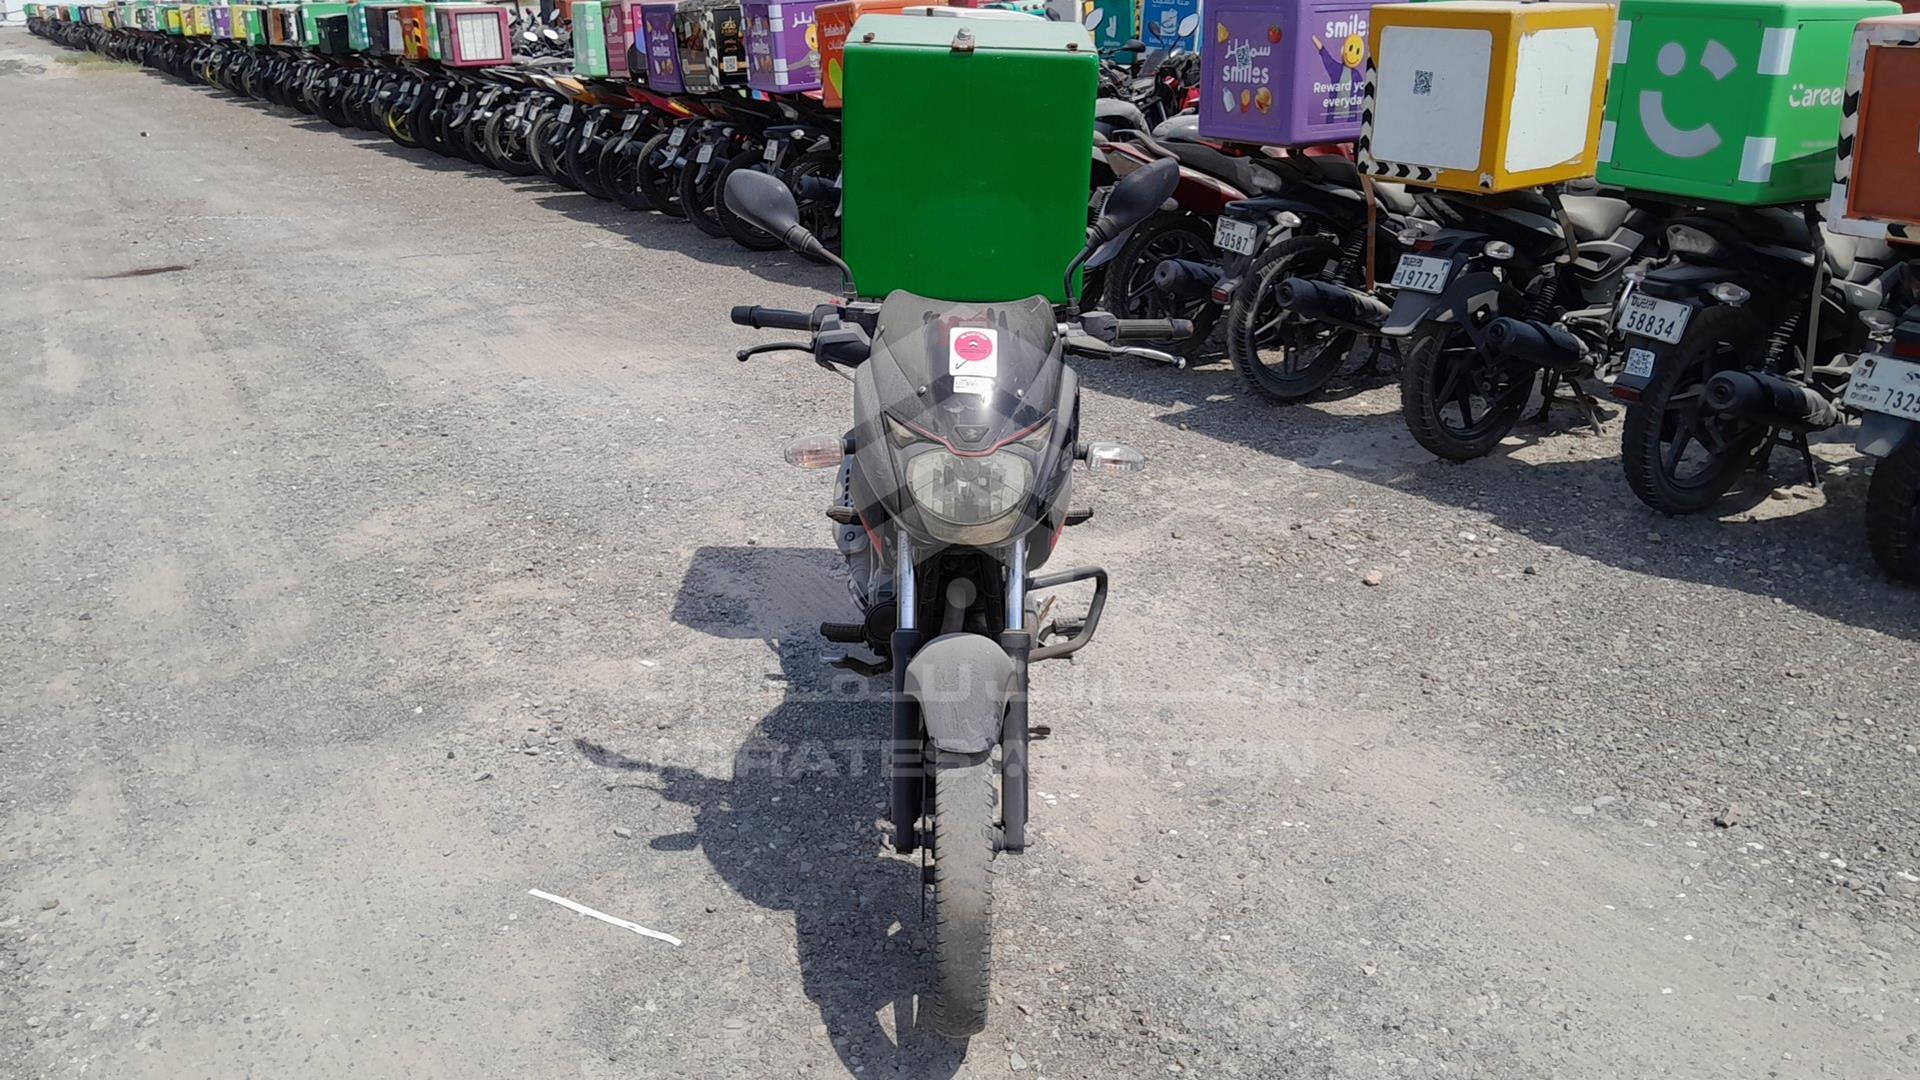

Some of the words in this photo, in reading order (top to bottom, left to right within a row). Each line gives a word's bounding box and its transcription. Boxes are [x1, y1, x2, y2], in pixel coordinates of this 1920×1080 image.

[1325, 13, 1368, 38] smile
[1222, 65, 1269, 84] smiles
[1313, 81, 1352, 93] Reward
[1788, 83, 1844, 107] Caree
[1322, 95, 1362, 109] everyda
[1218, 231, 1249, 251] 20587
[1398, 269, 1439, 290] 19772
[1626, 310, 1676, 339] 58834
